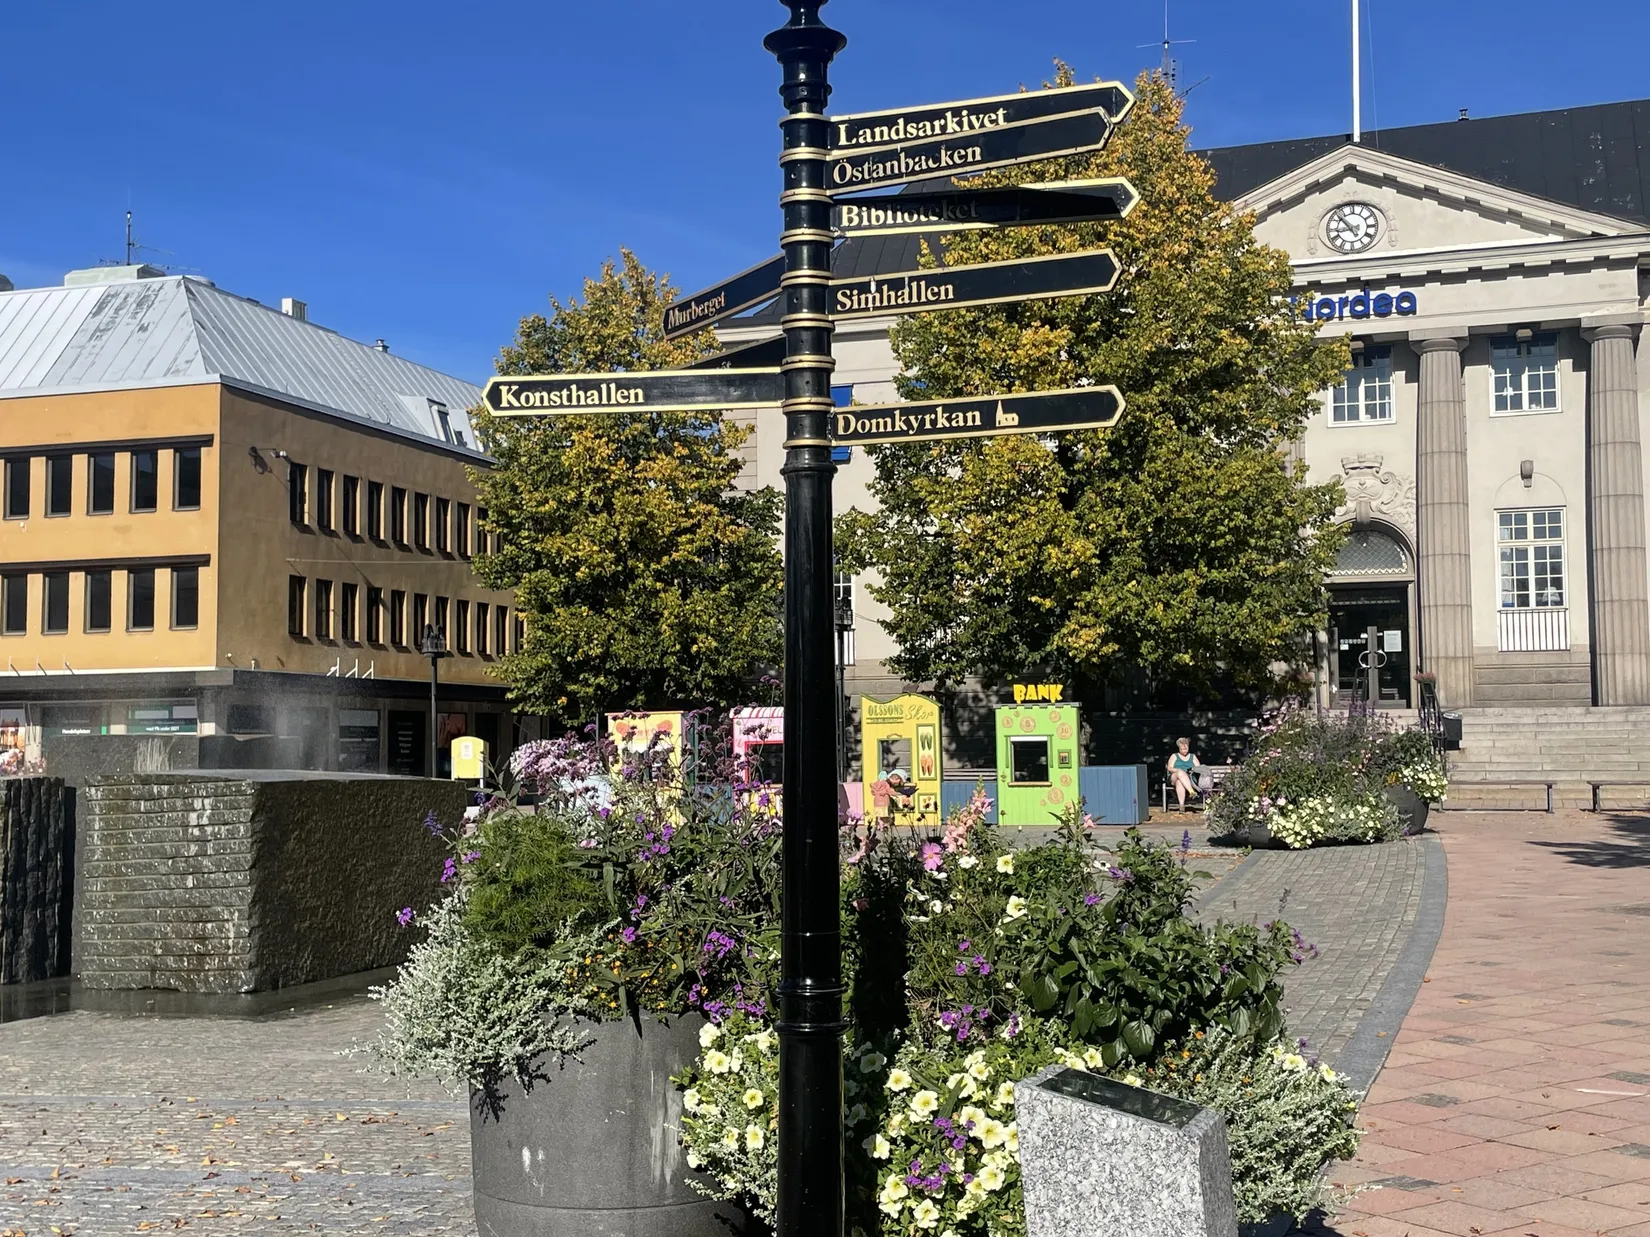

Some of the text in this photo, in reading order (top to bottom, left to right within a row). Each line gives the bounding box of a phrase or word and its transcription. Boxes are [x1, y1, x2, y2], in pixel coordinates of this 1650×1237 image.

[837, 107, 1008, 146] Landsarkivet
[840, 198, 980, 228] Biblioteket
[668, 291, 726, 329] Murberget
[836, 280, 954, 312] Simhallen
[1290, 286, 1417, 322] Nordea
[499, 382, 645, 408] Konsthallen
[837, 408, 982, 437] Domkyrkan
[1012, 684, 1064, 704] BANK
[867, 704, 904, 717] OLSSONS
